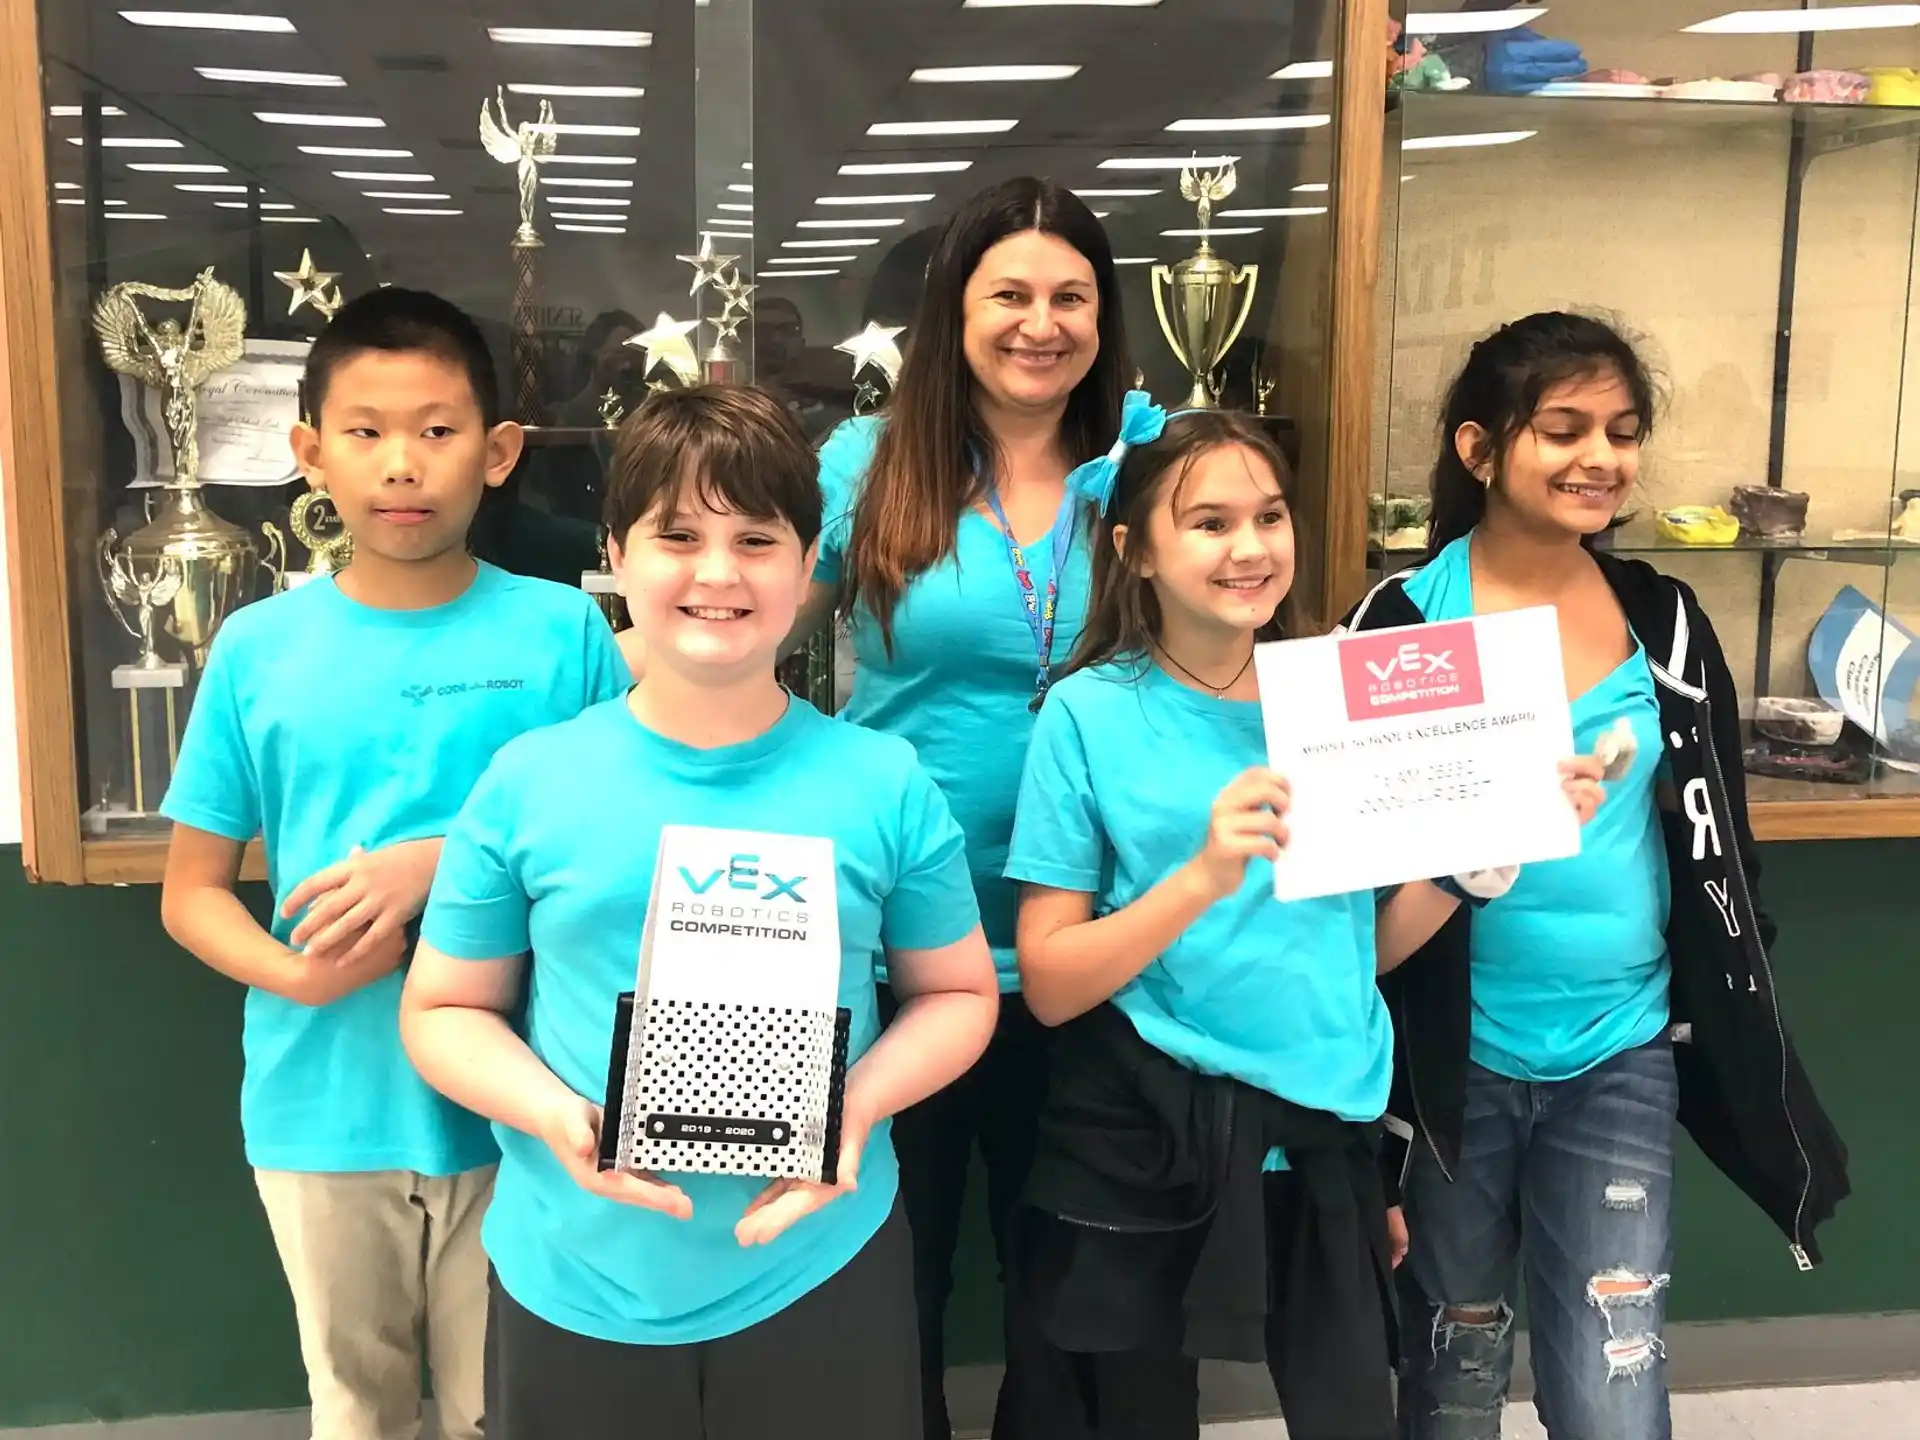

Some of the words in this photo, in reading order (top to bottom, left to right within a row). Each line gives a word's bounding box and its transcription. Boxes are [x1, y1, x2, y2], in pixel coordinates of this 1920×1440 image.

[1365, 642, 1455, 681] VEX
[486, 679, 524, 690] ROBOT
[1367, 672, 1458, 693] ROBOTICS
[1369, 684, 1460, 706] COMPETITION
[677, 853, 808, 903] VEX
[671, 902, 809, 923] ROBOTICS
[670, 919, 807, 941] COMPETITION
[681, 1124, 711, 1135] 2019
[725, 1126, 756, 1137] 2020
